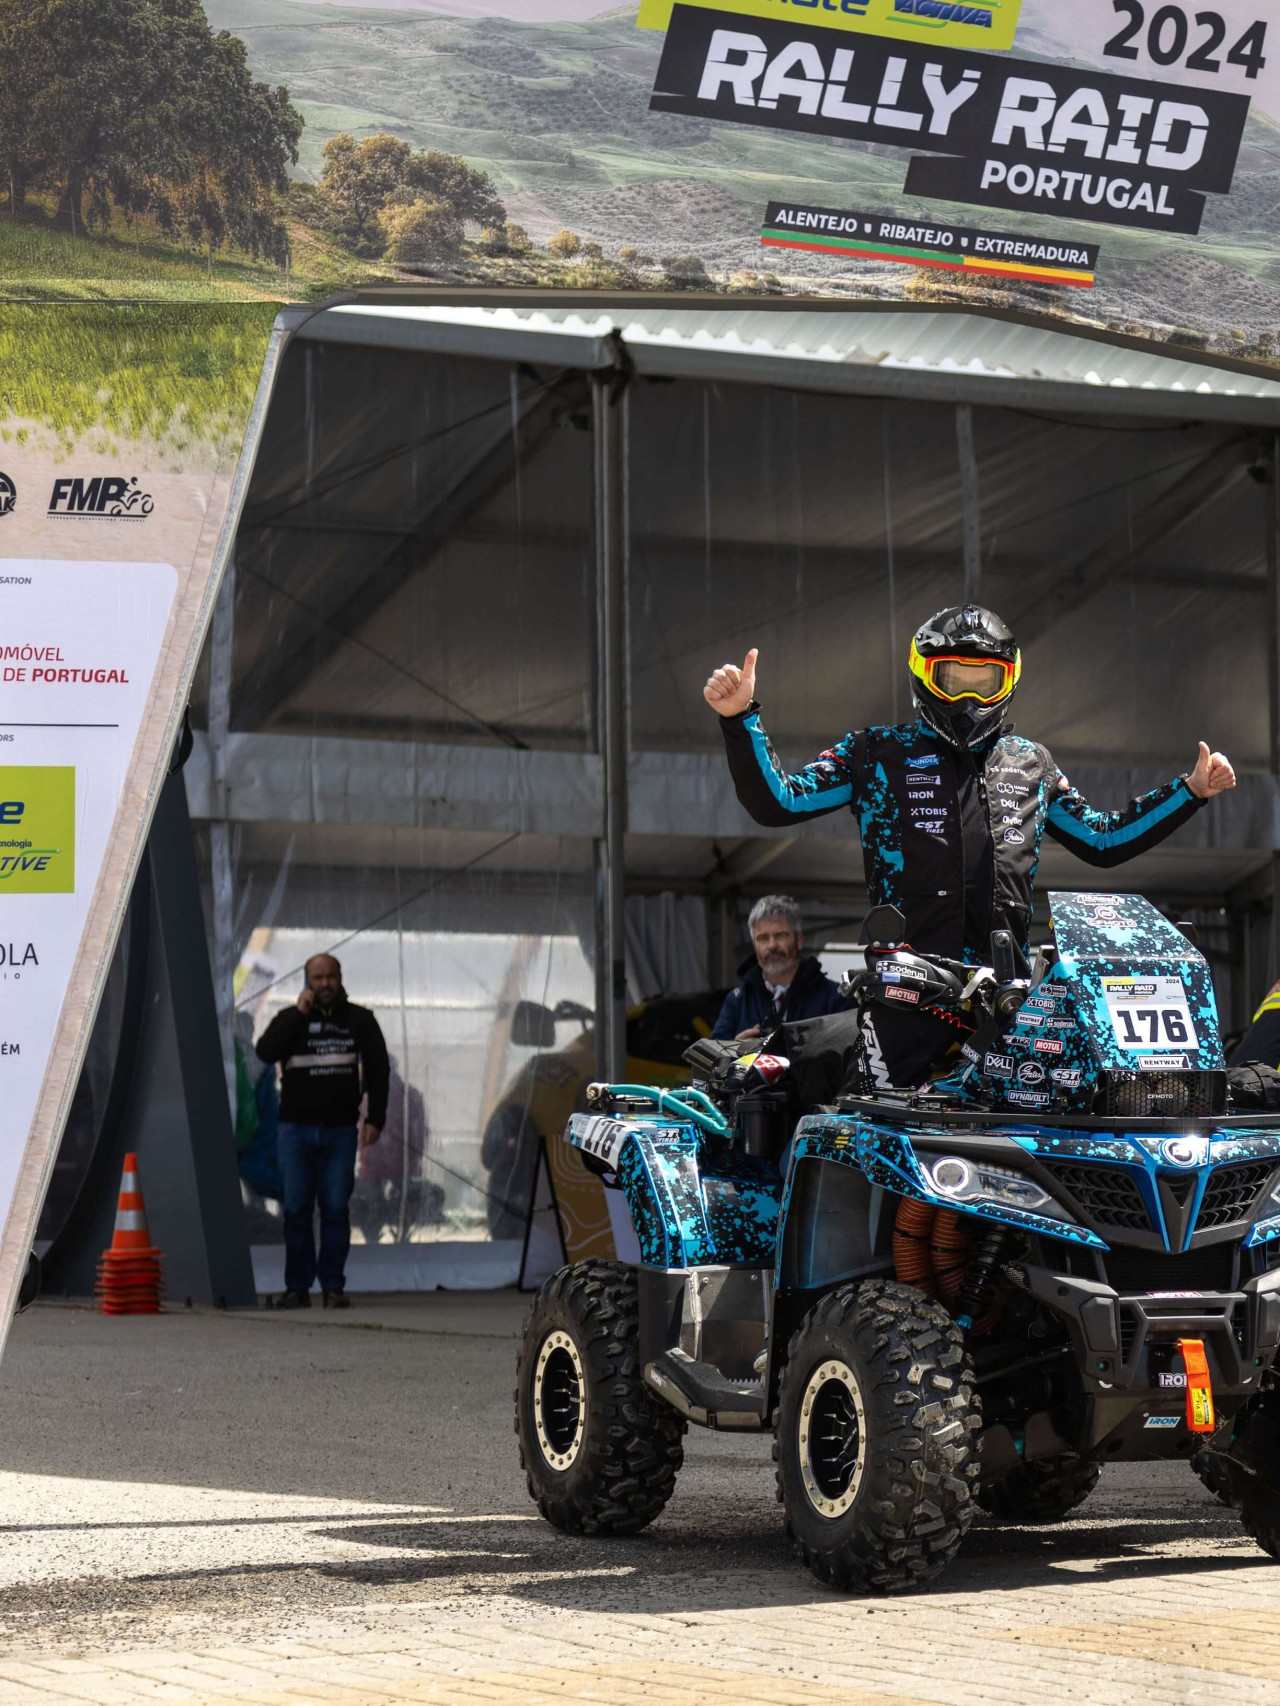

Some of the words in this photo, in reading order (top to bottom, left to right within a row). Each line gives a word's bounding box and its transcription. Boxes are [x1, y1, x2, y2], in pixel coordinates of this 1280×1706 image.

[1103, 4, 1268, 79] 2024
[697, 28, 983, 136] RALLY
[991, 76, 1210, 171] RAID
[979, 158, 1175, 215] PORTUGAL
[775, 209, 857, 233] ALENTEJO
[879, 222, 954, 247] RIBATEJO
[974, 236, 1089, 265] EXTREMADURA
[49, 477, 127, 511] FMP
[3, 668, 26, 681] DE
[32, 668, 129, 683] PORTUGAL
[908, 790, 934, 799] IRON
[919, 808, 948, 816] TOBIS
[1000, 799, 1020, 811] DELL
[914, 821, 944, 829] CST
[890, 965, 924, 979] soderus
[888, 988, 917, 1001] MOTUL
[1034, 998, 1054, 1009] TOBIS
[1117, 1010, 1189, 1043] 176
[861, 1011, 894, 1088] KENN
[962, 1044, 980, 1061] IRON
[1036, 1042, 1061, 1051] MOTUL
[986, 1055, 1011, 1070] DELL
[1052, 1069, 1079, 1080] CST
[1009, 1092, 1048, 1102] DYNAVOLT
[584, 1118, 626, 1159] 176
[1149, 1417, 1178, 1425] IRON
